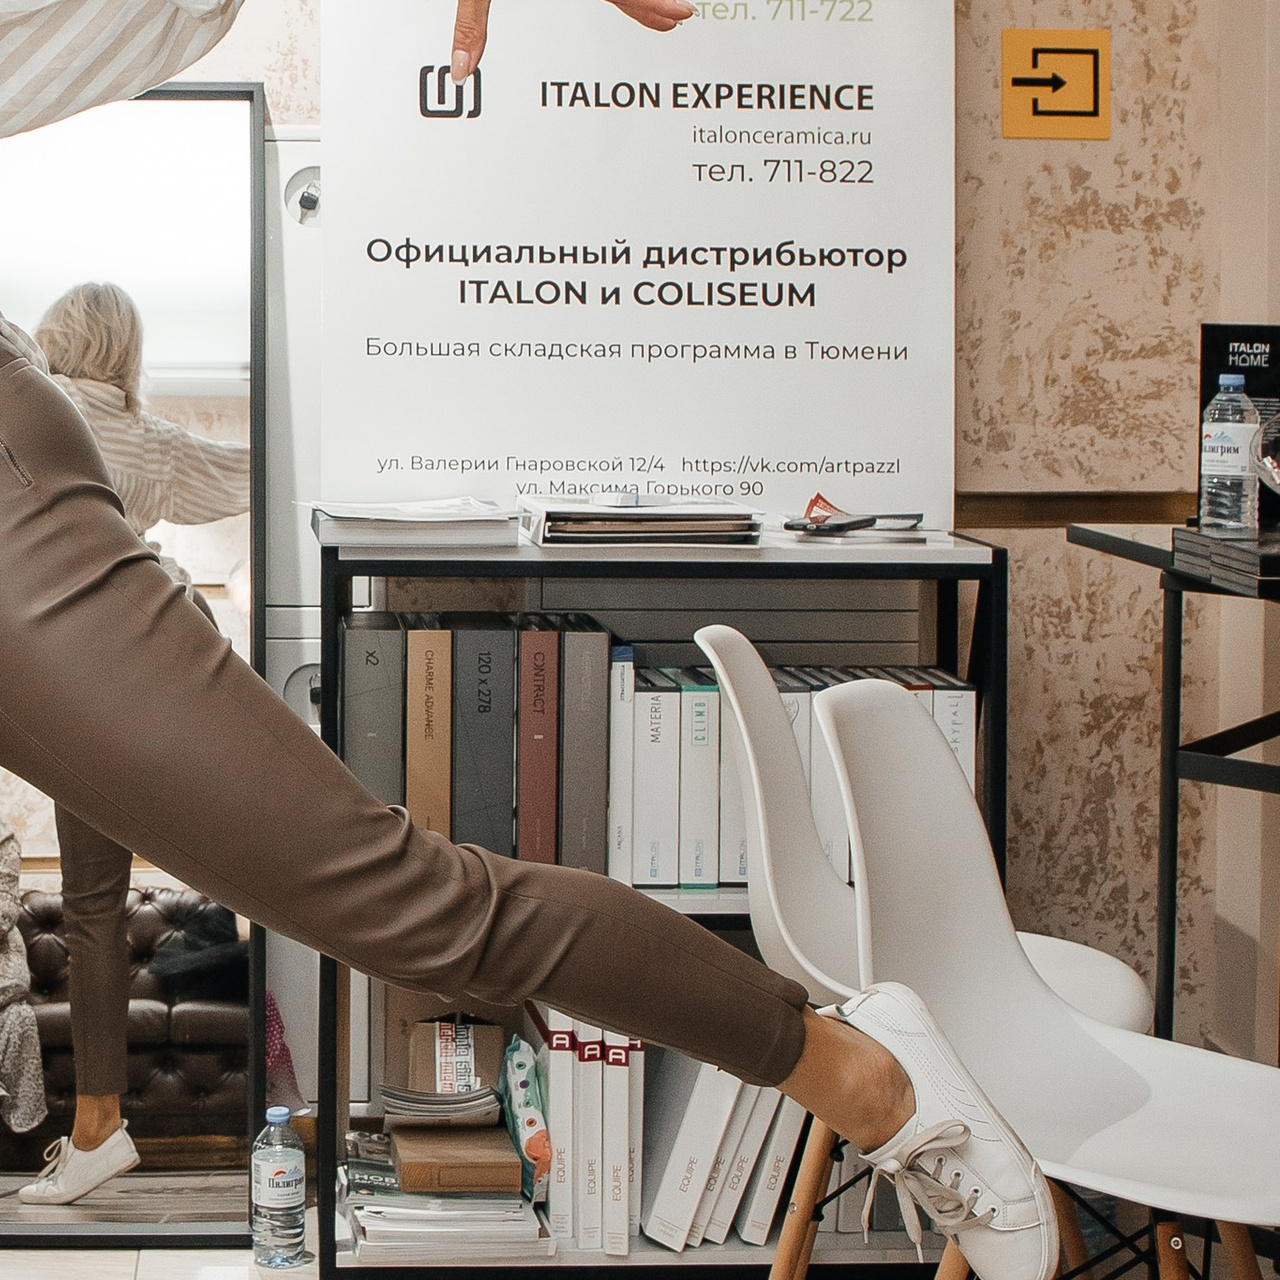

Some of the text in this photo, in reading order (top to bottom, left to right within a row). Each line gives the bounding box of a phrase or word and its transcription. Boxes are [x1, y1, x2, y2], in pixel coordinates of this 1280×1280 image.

[696, 2, 756, 21] тел.
[541, 81, 874, 111] ITALON EXPERIENCE
[692, 125, 872, 146] italonceramica.ru
[691, 159, 875, 184] тел. 711-822
[366, 237, 908, 272] Официальный дистрибьютор
[459, 279, 816, 308] ITALON и COLISEUM
[366, 336, 908, 364] Большая складская программа в Тюмени
[1228, 342, 1270, 353] ITALON
[1228, 353, 1270, 367] HOME
[377, 454, 901, 477] ул. Валерии Гнаровской 12/4 https://vk.com/artpazzl
[516, 480, 764, 496] ул. Максима Горького 90
[424, 650, 434, 692] CHARME
[478, 651, 492, 674] 120
[532, 651, 545, 715] CONTRACT
[478, 688, 492, 714] 278
[650, 695, 662, 744] MATERIA
[693, 701, 707, 741] CLIMB
[557, 1148, 566, 1183] EQUIPE
[587, 1159, 597, 1195] EQUIPE
[679, 1155, 698, 1193] EQUIPE
[728, 1155, 750, 1191] EQUIPE
[766, 1155, 785, 1192] EQUIPE
[612, 1164, 622, 1202] EQUIPE
